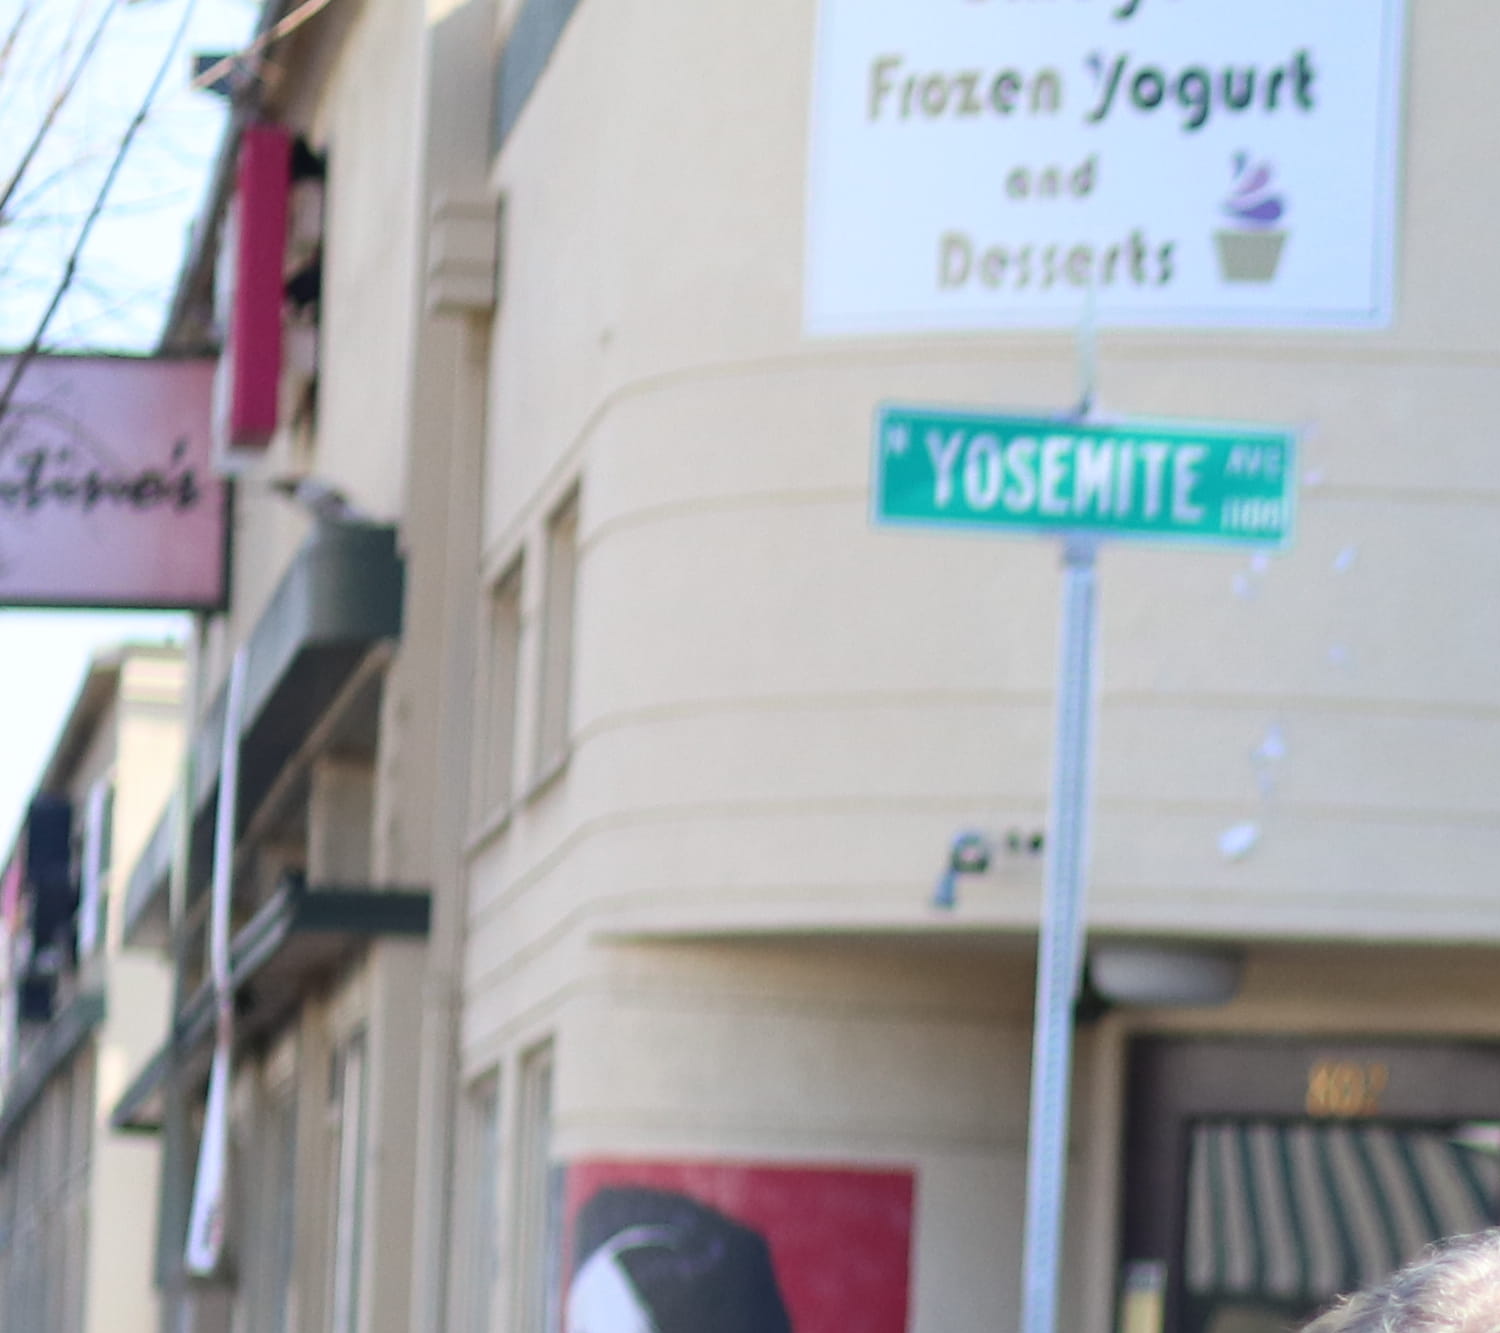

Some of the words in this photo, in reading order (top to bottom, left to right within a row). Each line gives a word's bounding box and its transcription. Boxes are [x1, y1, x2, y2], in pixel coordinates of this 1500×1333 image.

[868, 55, 1062, 120] Frozen
[1085, 50, 1315, 131] Yogurt
[1006, 155, 1097, 198] and
[938, 231, 1173, 288] Desserts
[927, 428, 1208, 523] YOSEMITE
